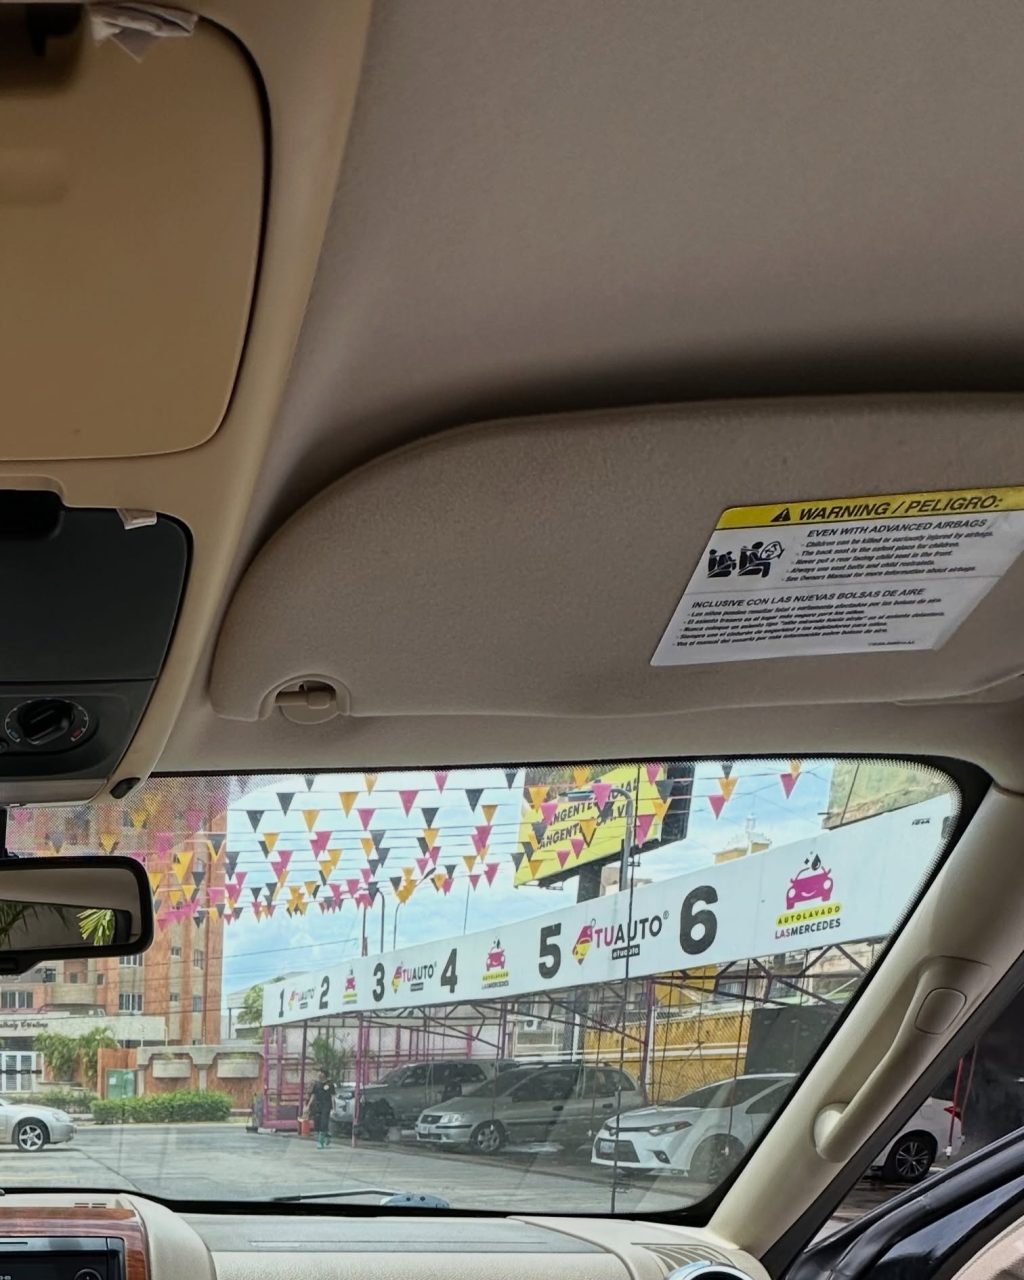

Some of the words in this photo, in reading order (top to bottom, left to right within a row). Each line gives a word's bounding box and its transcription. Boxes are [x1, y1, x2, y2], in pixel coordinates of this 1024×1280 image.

[799, 502, 891, 520] WARNING
[904, 495, 1004, 514] PELIGRO:
[807, 528, 838, 537] EVEN
[839, 525, 869, 535] WITH
[869, 521, 932, 534] ADVANCED
[933, 518, 988, 530] AIRBAGS
[692, 599, 744, 609] INCLUSIVE
[746, 597, 770, 607] CON
[771, 595, 794, 605] LAS
[793, 592, 835, 603] NUEVAS
[837, 590, 881, 600] BOLSAS
[881, 589, 898, 598] DE
[897, 587, 927, 597] AIRE
[679, 885, 718, 955] 6
[775, 917, 841, 940] LASMERCEDES
[778, 905, 841, 925] AUTOLAVADO
[538, 922, 561, 979] 5
[372, 962, 385, 1002] 3
[440, 947, 457, 994] 4
[278, 988, 284, 1018] 1
[319, 975, 330, 1010] 2
